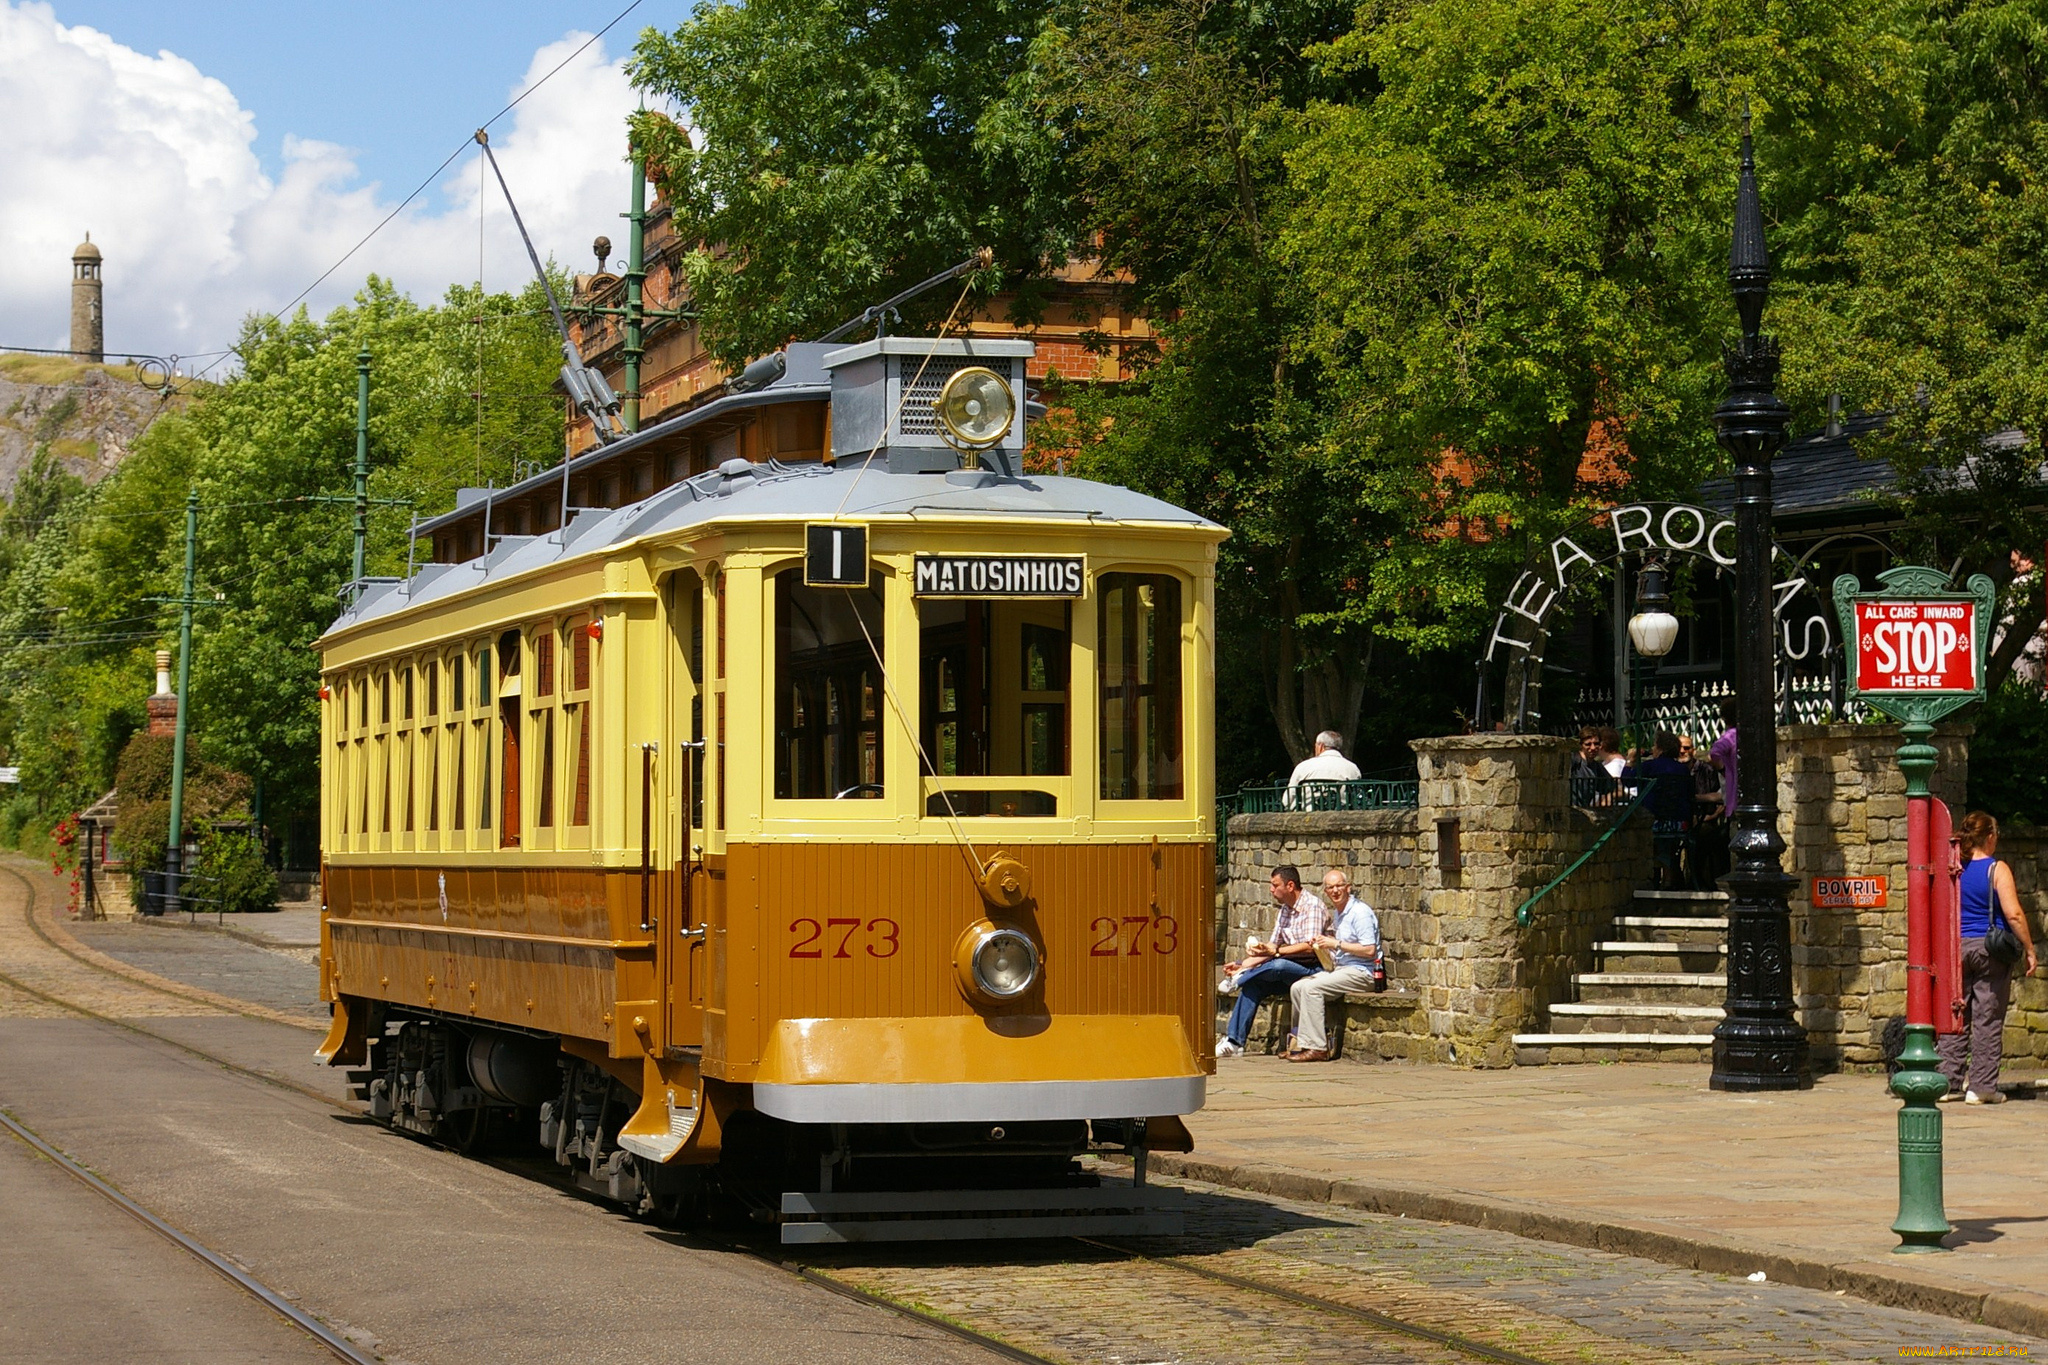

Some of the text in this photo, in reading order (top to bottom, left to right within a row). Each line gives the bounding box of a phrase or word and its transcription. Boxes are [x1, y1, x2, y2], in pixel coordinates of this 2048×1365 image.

[917, 560, 1081, 592] MATOSINHOS
[1485, 536, 1597, 662] TEA
[1865, 607, 1965, 619] ALL CARS INWARD
[1874, 621, 1957, 674] STOP
[1891, 675, 1942, 687] HERE
[1817, 880, 1882, 896] BOVRIL
[1823, 896, 1857, 905] SERVED
[788, 918, 900, 958] 273
[1090, 916, 1178, 957] 273
